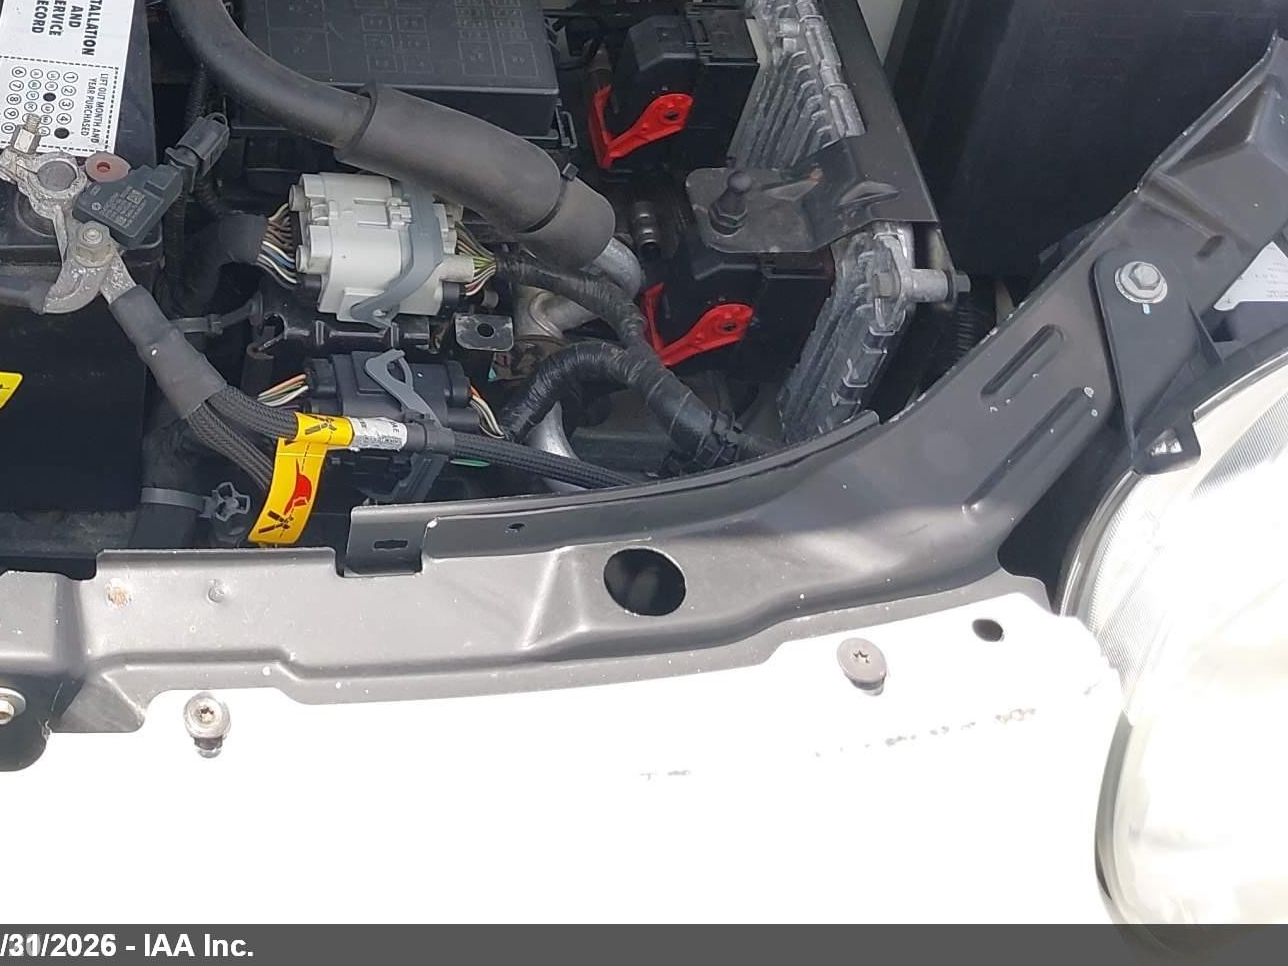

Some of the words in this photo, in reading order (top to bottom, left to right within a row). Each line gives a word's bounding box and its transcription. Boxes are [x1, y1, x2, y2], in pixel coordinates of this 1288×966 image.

[68, 5, 83, 28] AND
[87, 78, 97, 94] YEAR
[99, 73, 108, 86] LIFT
[97, 87, 107, 100] OUT
[80, 95, 95, 136] PURCHASED
[93, 101, 104, 127] MONTH
[90, 128, 101, 144] AND
